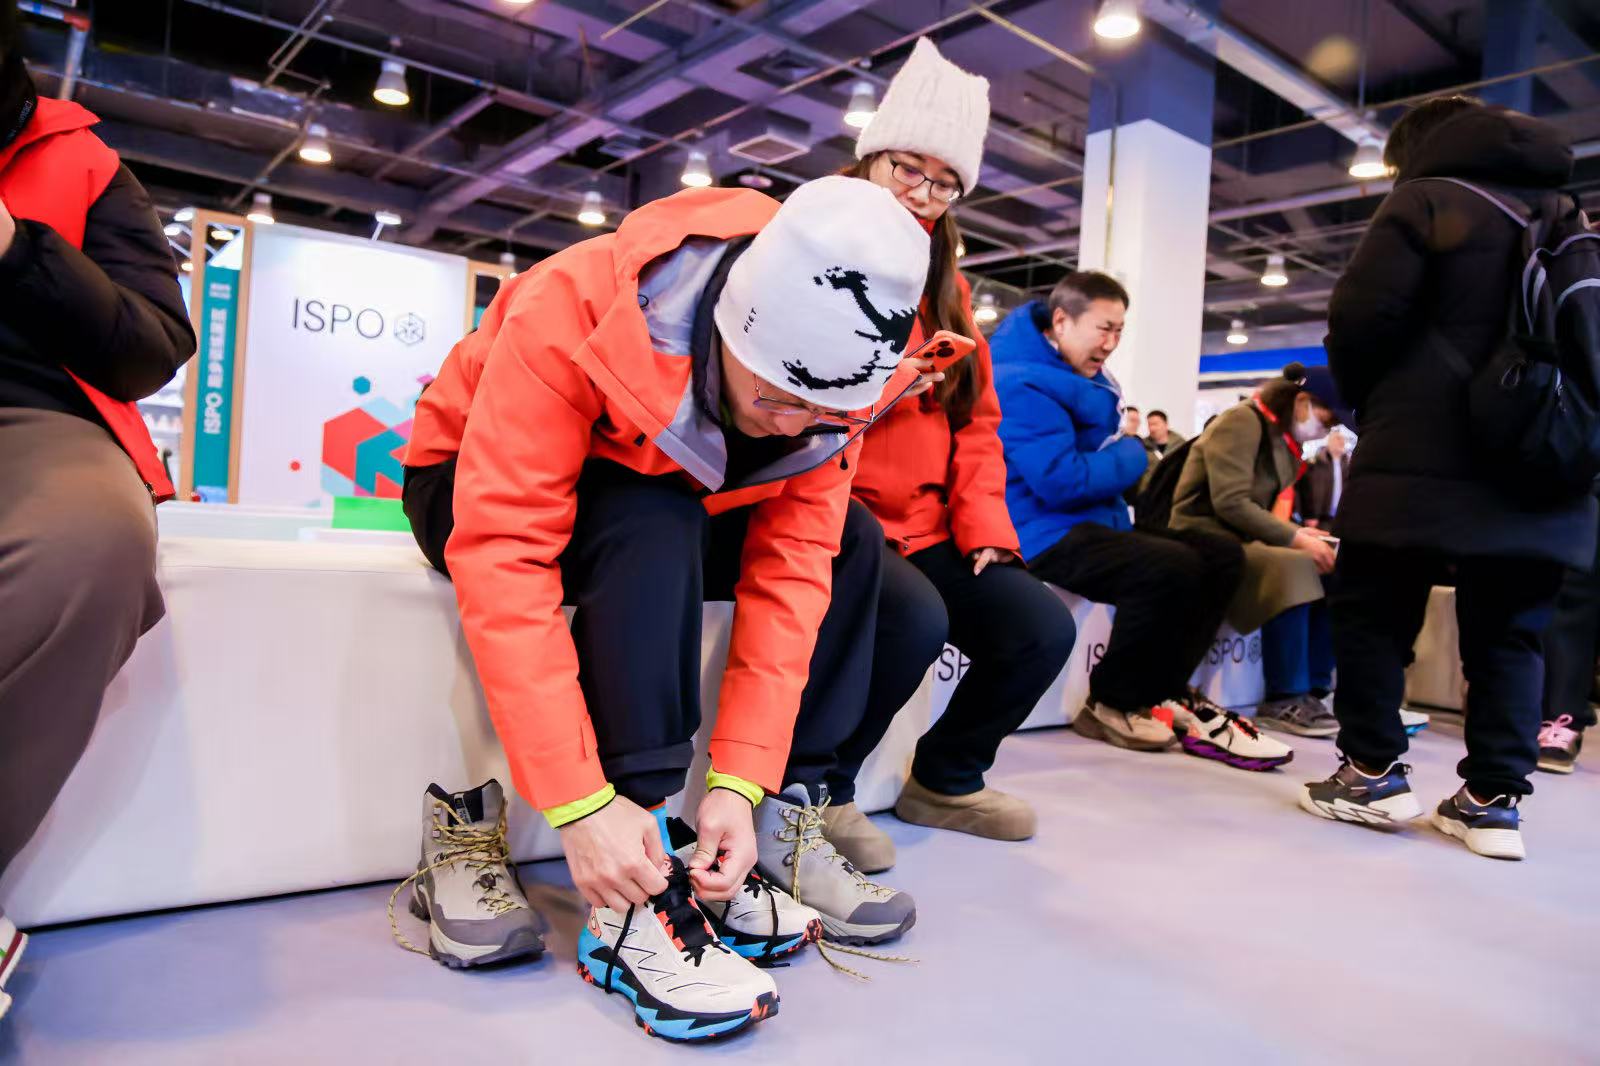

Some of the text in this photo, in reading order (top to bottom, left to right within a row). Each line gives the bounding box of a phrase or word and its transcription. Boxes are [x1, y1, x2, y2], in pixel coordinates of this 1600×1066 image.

[293, 298, 384, 339] ISPO
[743, 307, 757, 334] PIET
[203, 391, 223, 435] ISPO
